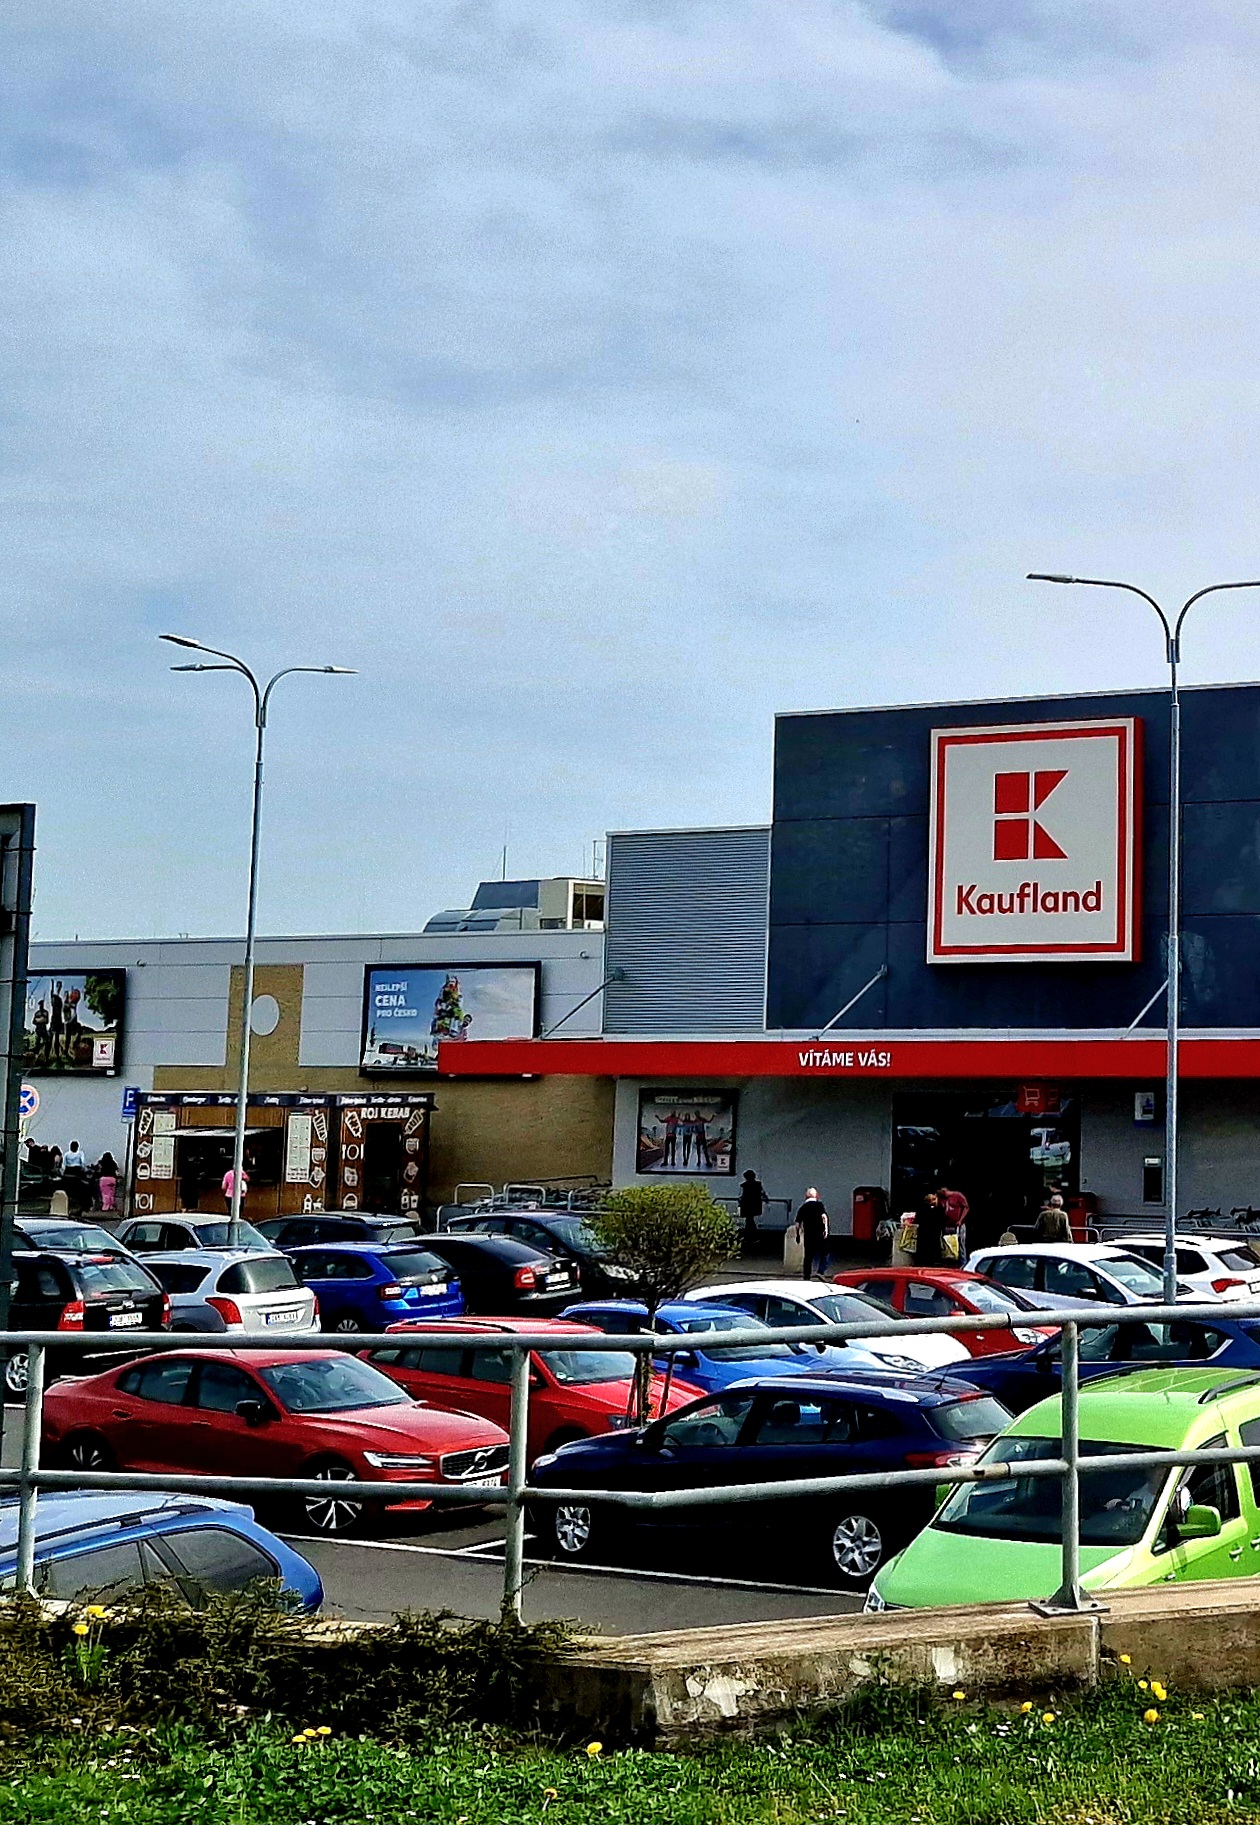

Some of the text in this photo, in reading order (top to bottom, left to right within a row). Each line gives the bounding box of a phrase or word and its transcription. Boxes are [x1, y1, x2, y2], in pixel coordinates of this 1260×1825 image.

[994, 770, 1069, 861] K
[956, 881, 1102, 915] Kaufland
[375, 994, 406, 1007] CENA
[376, 1008, 418, 1018] PRO ČESKO
[798, 1049, 891, 1067] VÍTÁME VÁS!
[380, 1107, 411, 1119] KEBAB
